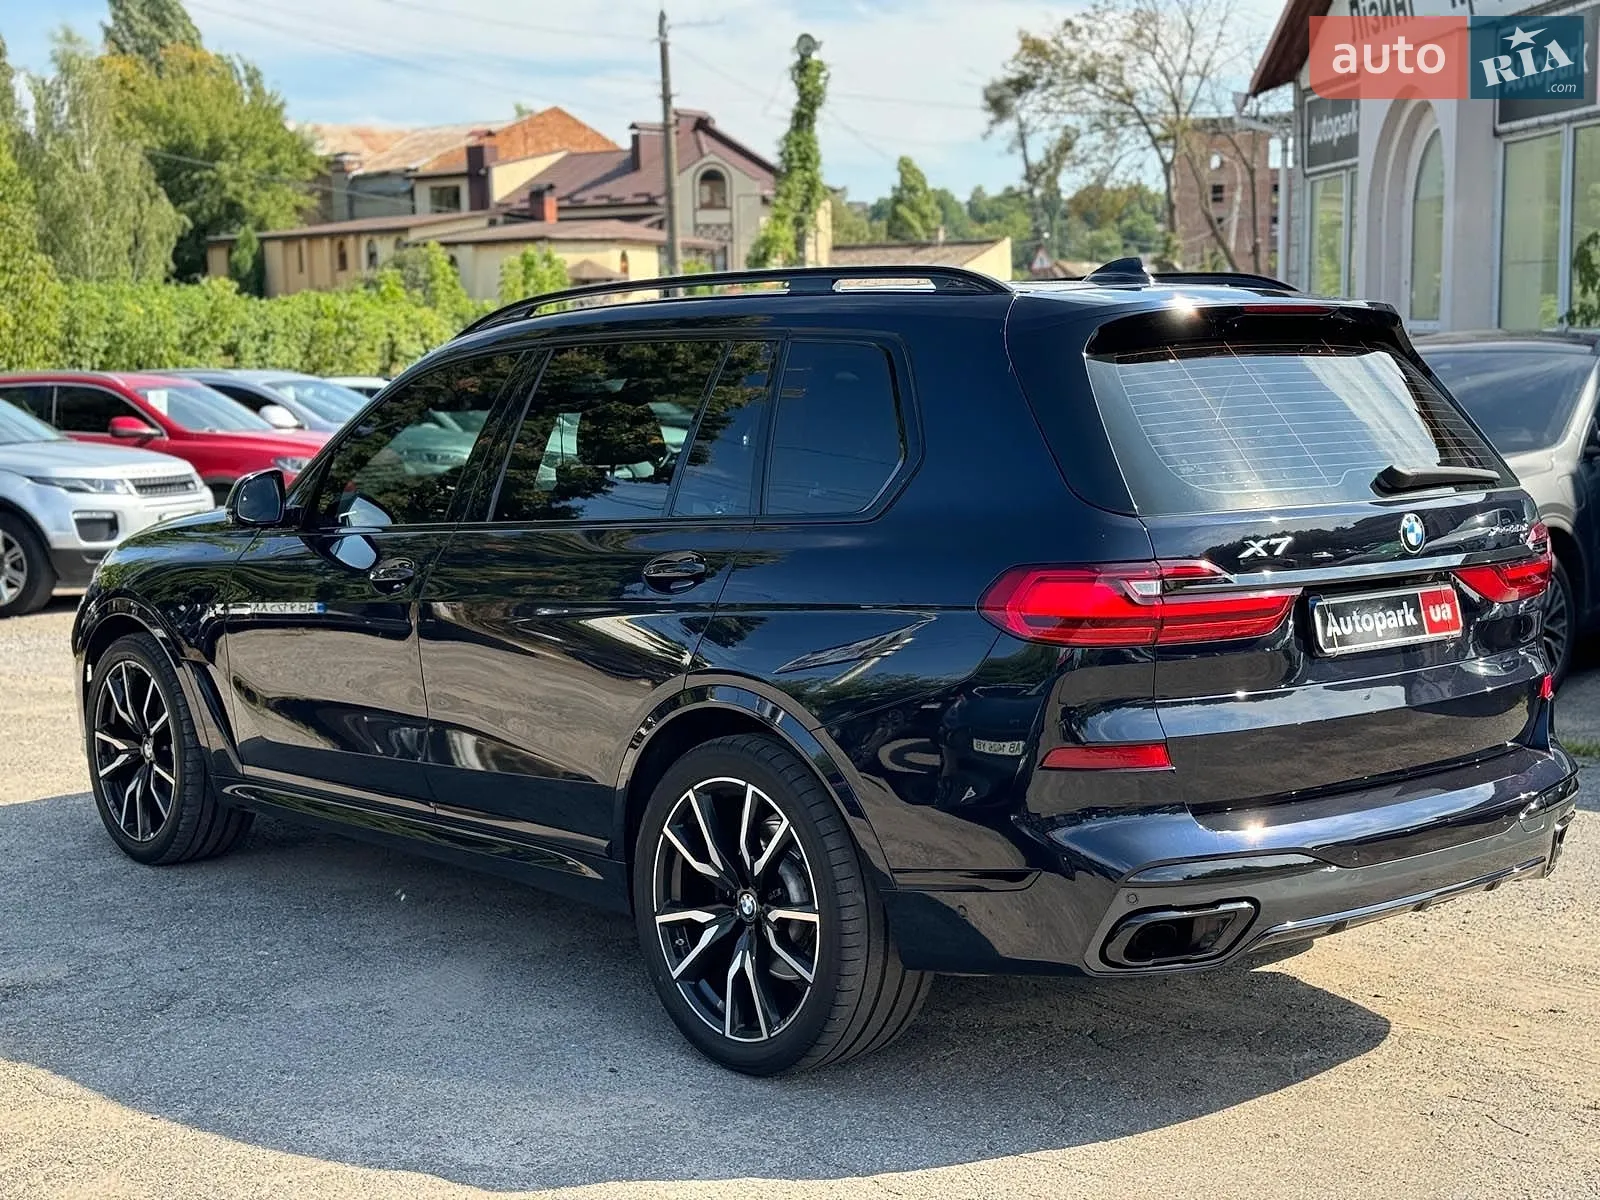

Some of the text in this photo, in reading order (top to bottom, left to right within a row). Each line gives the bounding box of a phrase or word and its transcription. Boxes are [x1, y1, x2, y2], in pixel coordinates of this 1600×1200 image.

[1238, 536, 1293, 558] X7
[1326, 601, 1453, 638] Autopark ua
